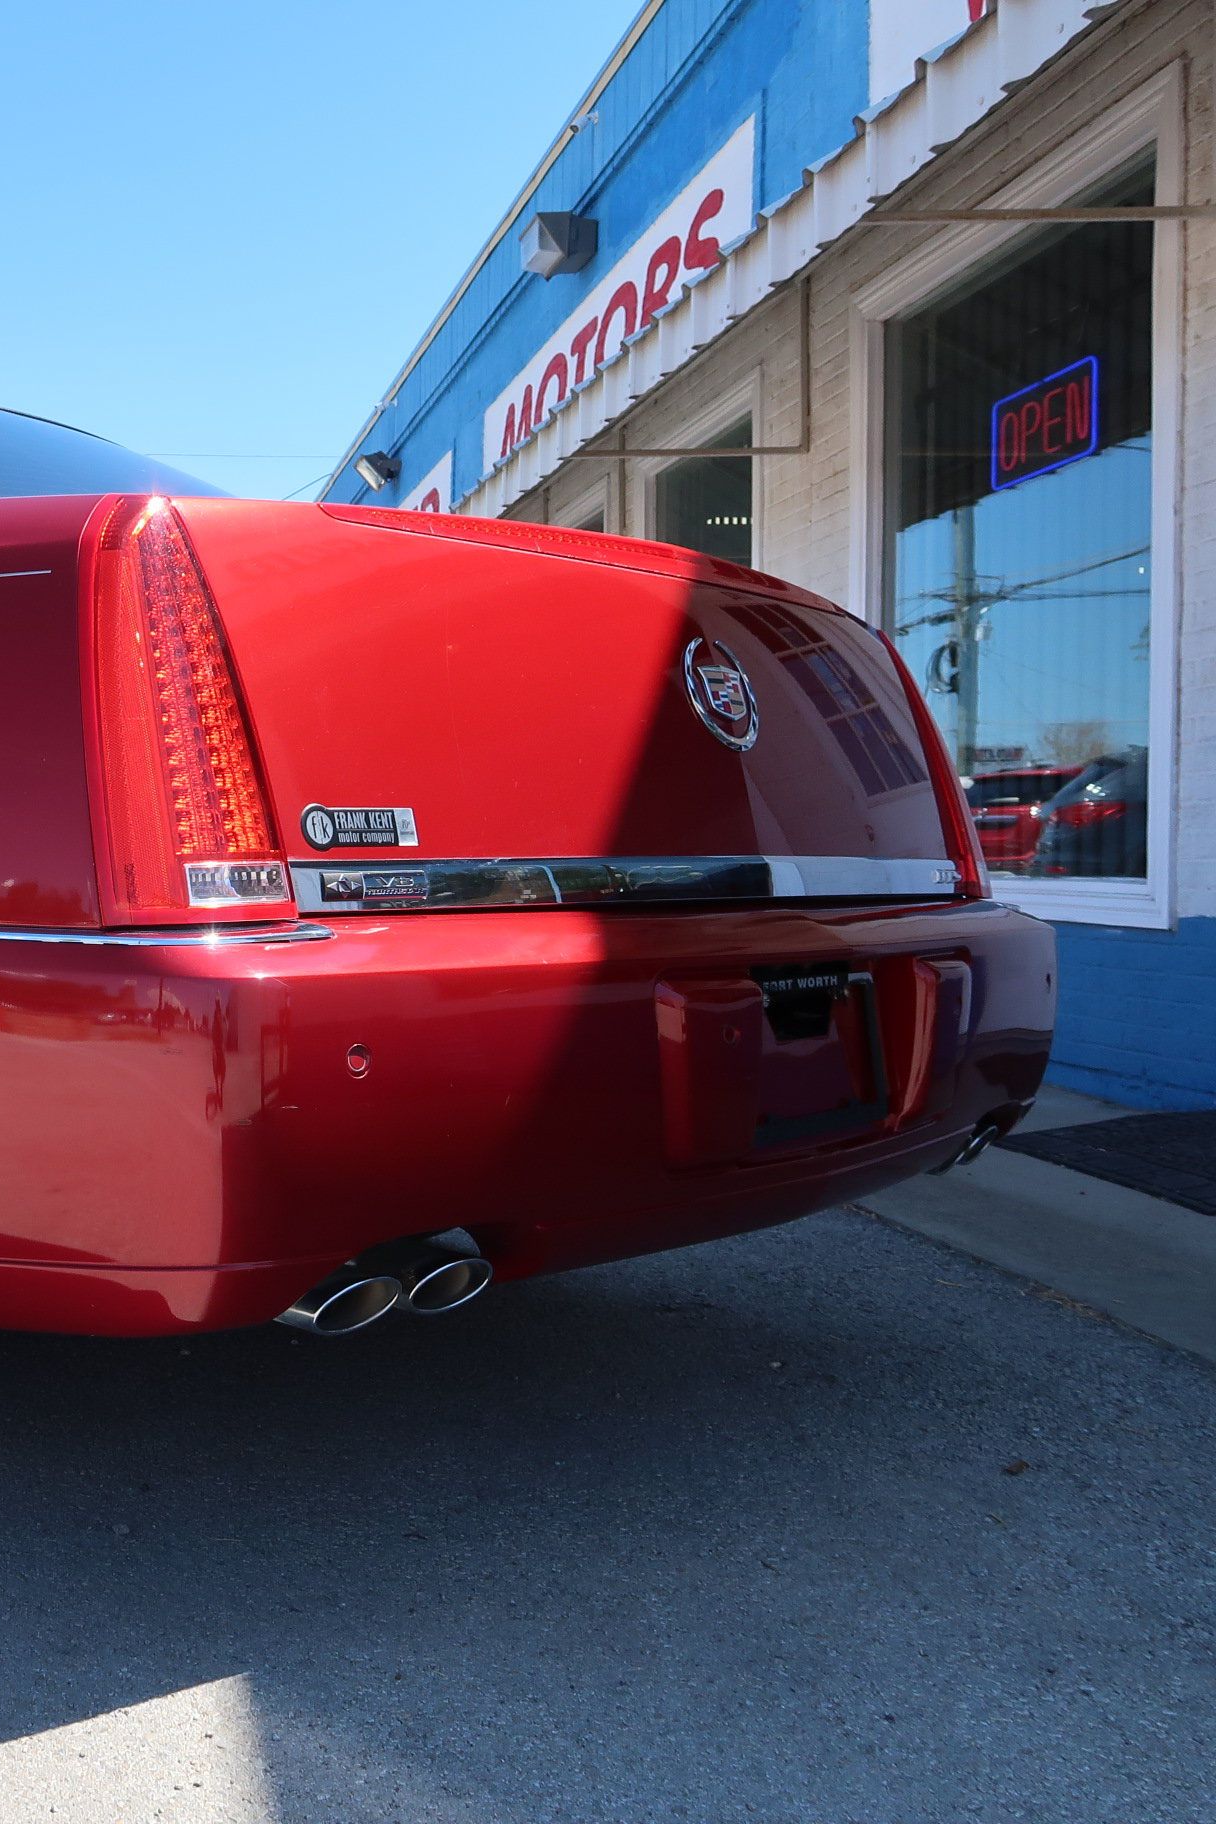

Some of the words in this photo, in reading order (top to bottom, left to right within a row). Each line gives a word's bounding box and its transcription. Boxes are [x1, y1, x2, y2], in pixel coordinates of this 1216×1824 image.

[999, 375, 1090, 472] OPEN
[333, 811, 368, 829] FRANK
[368, 811, 394, 829] KENT
[338, 831, 360, 843] motor
[362, 832, 395, 844] company
[797, 975, 838, 989] WORTH
